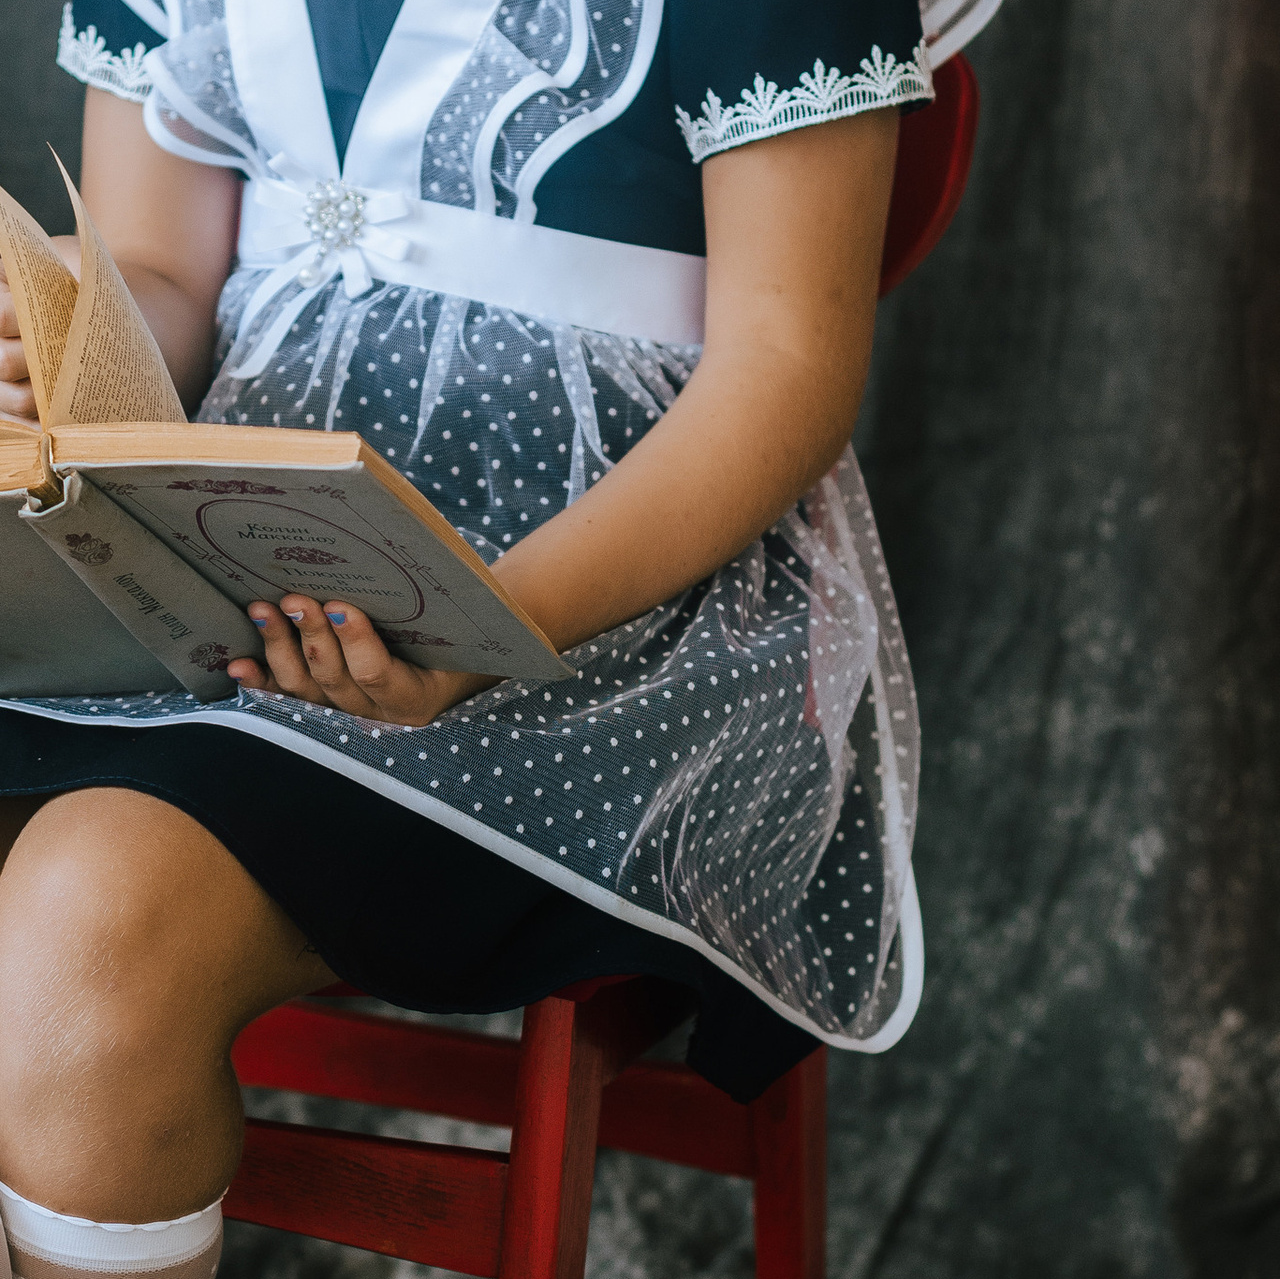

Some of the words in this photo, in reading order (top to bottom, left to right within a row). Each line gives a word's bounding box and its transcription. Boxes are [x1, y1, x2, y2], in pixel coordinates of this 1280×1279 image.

[246, 522, 310, 535] Колин
[237, 530, 337, 545] Маккалоу
[113, 572, 164, 615] Маккалоу
[287, 581, 405, 598] терновнике
[157, 612, 193, 640] Колин
